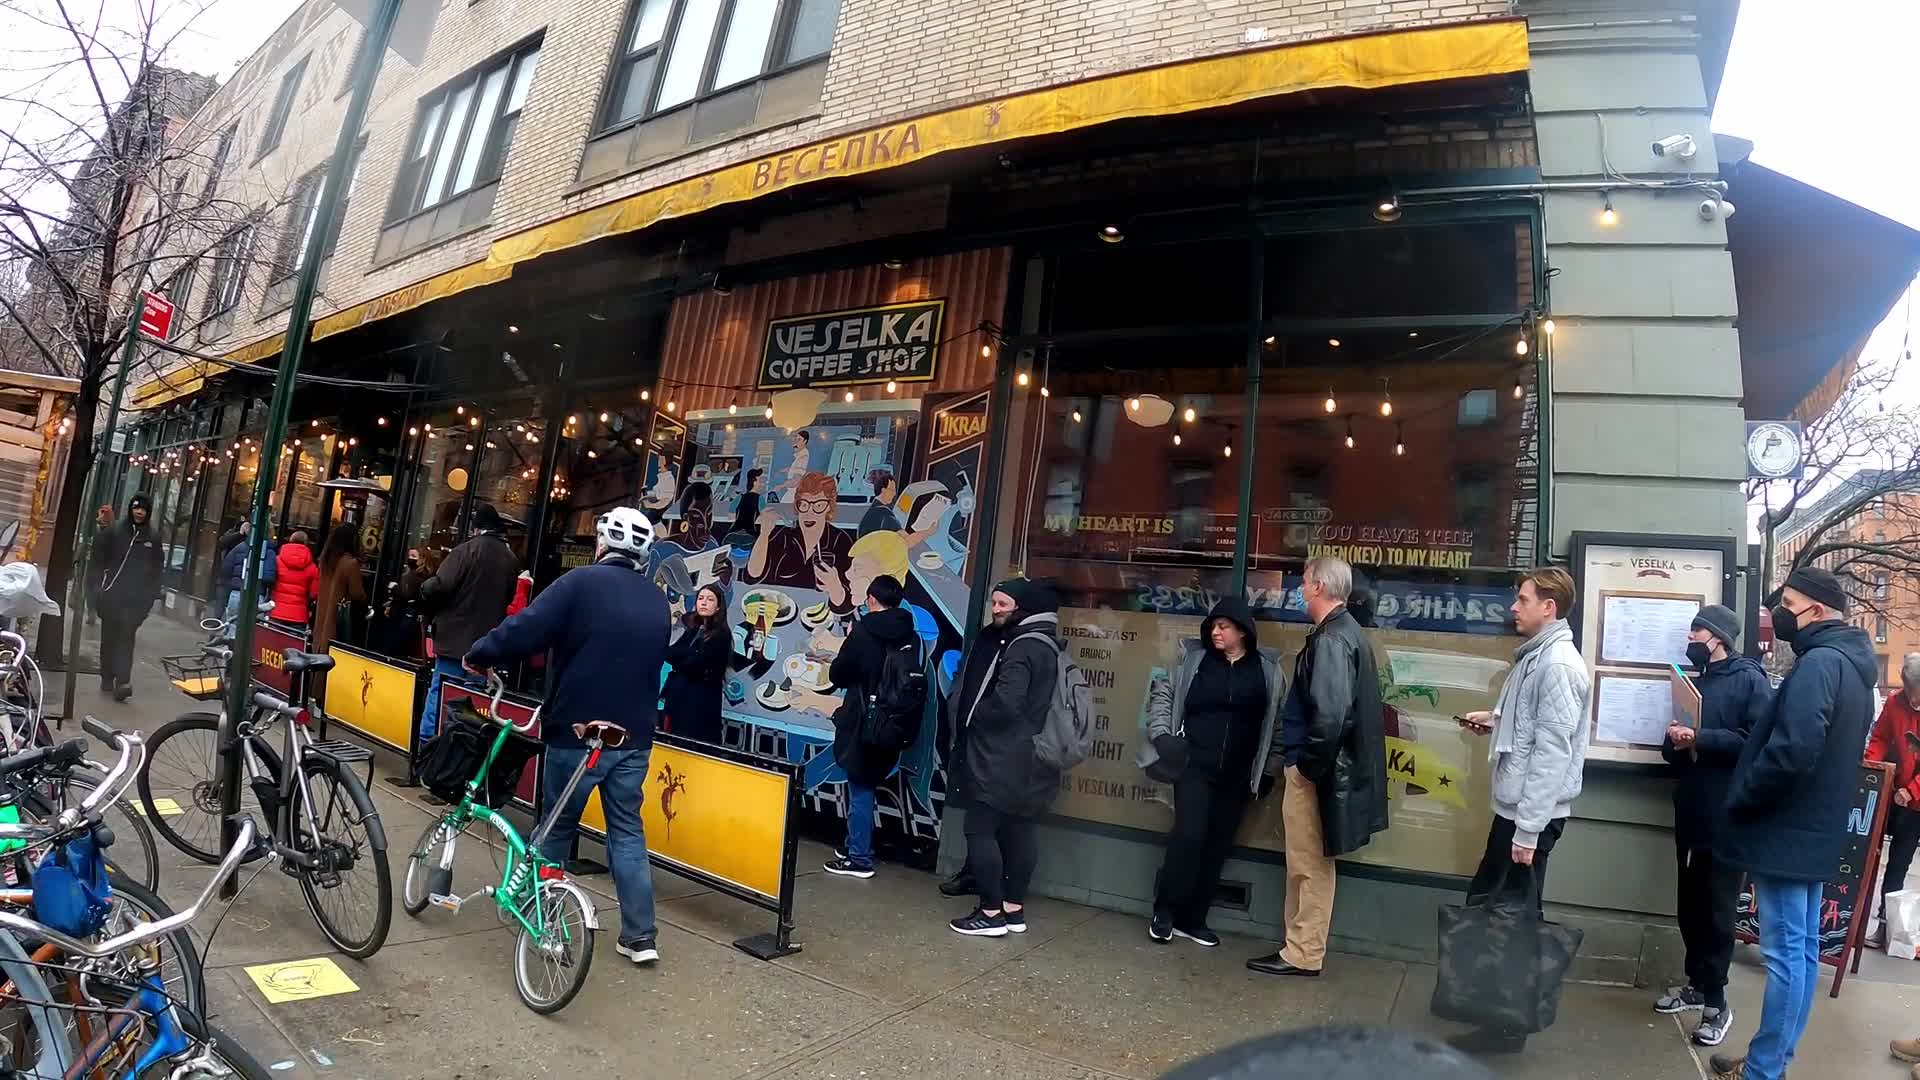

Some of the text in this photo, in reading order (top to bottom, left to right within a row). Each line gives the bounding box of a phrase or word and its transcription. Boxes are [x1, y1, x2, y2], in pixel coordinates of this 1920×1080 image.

[776, 310, 933, 354] VESELKA
[769, 346, 927, 379] COFFEE SHOP
[1044, 514, 1175, 534] MY HEART IS
[1311, 525, 1474, 546] YOU HAVE THE
[1387, 547, 1403, 566] TO
[1406, 549, 1426, 567] MY
[1429, 551, 1473, 568] HEART
[1630, 558, 1676, 570] VESELKA
[1063, 626, 1138, 642] BREAKFAST
[1080, 647, 1112, 660] BRUNCH
[1090, 740, 1125, 761] IGHT
[1077, 777, 1125, 799] VESELKA
